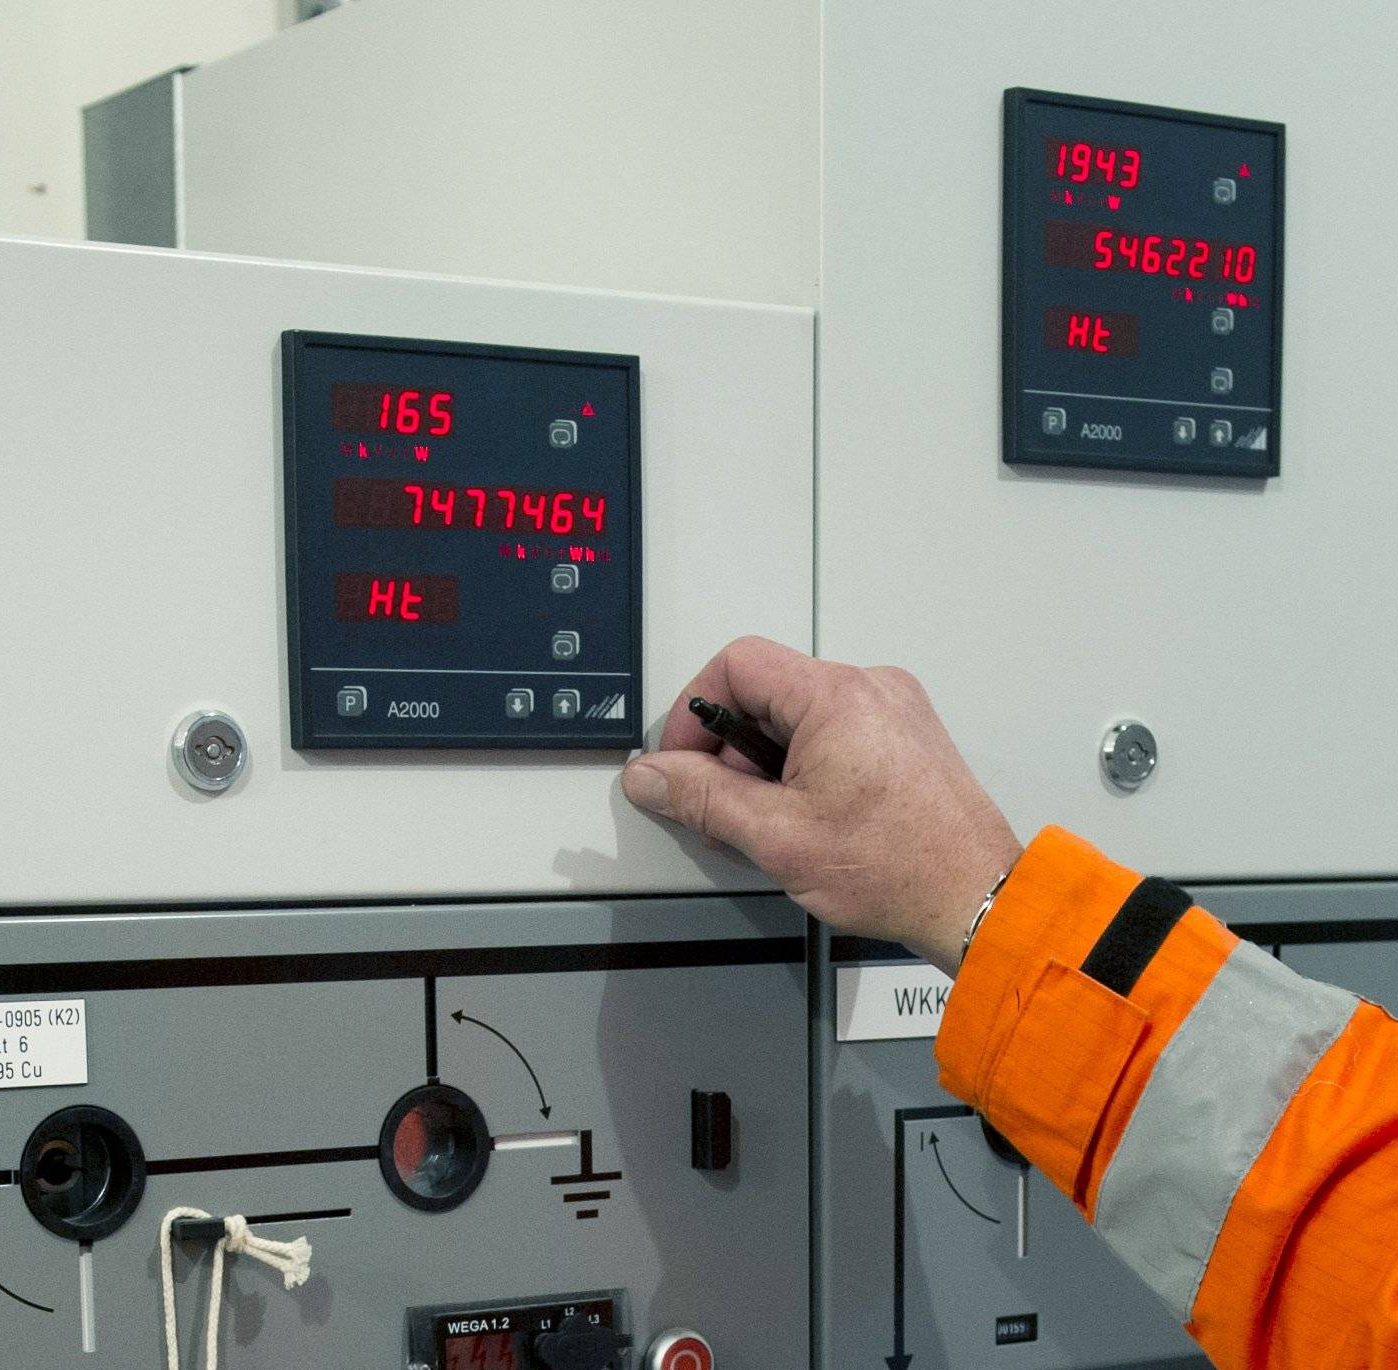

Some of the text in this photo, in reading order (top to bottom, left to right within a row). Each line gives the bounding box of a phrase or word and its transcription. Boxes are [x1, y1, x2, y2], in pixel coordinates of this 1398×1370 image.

[1056, 142, 1141, 189] 1943
[1094, 230, 1257, 285] 5462210
[379, 391, 452, 437] 165
[1080, 421, 1122, 441] A2000
[404, 485, 605, 534] 7477464
[345, 695, 357, 713] P
[387, 701, 440, 719] A2000
[48, 1007, 81, 1027] (K2)
[19, 1036, 29, 1053] 6
[21, 1061, 42, 1079] Cu
[565, 1307, 576, 1317] L2
[588, 1314, 600, 1325] L3
[447, 1317, 510, 1334] WEGA 1.2
[541, 1319, 551, 1330] L1
